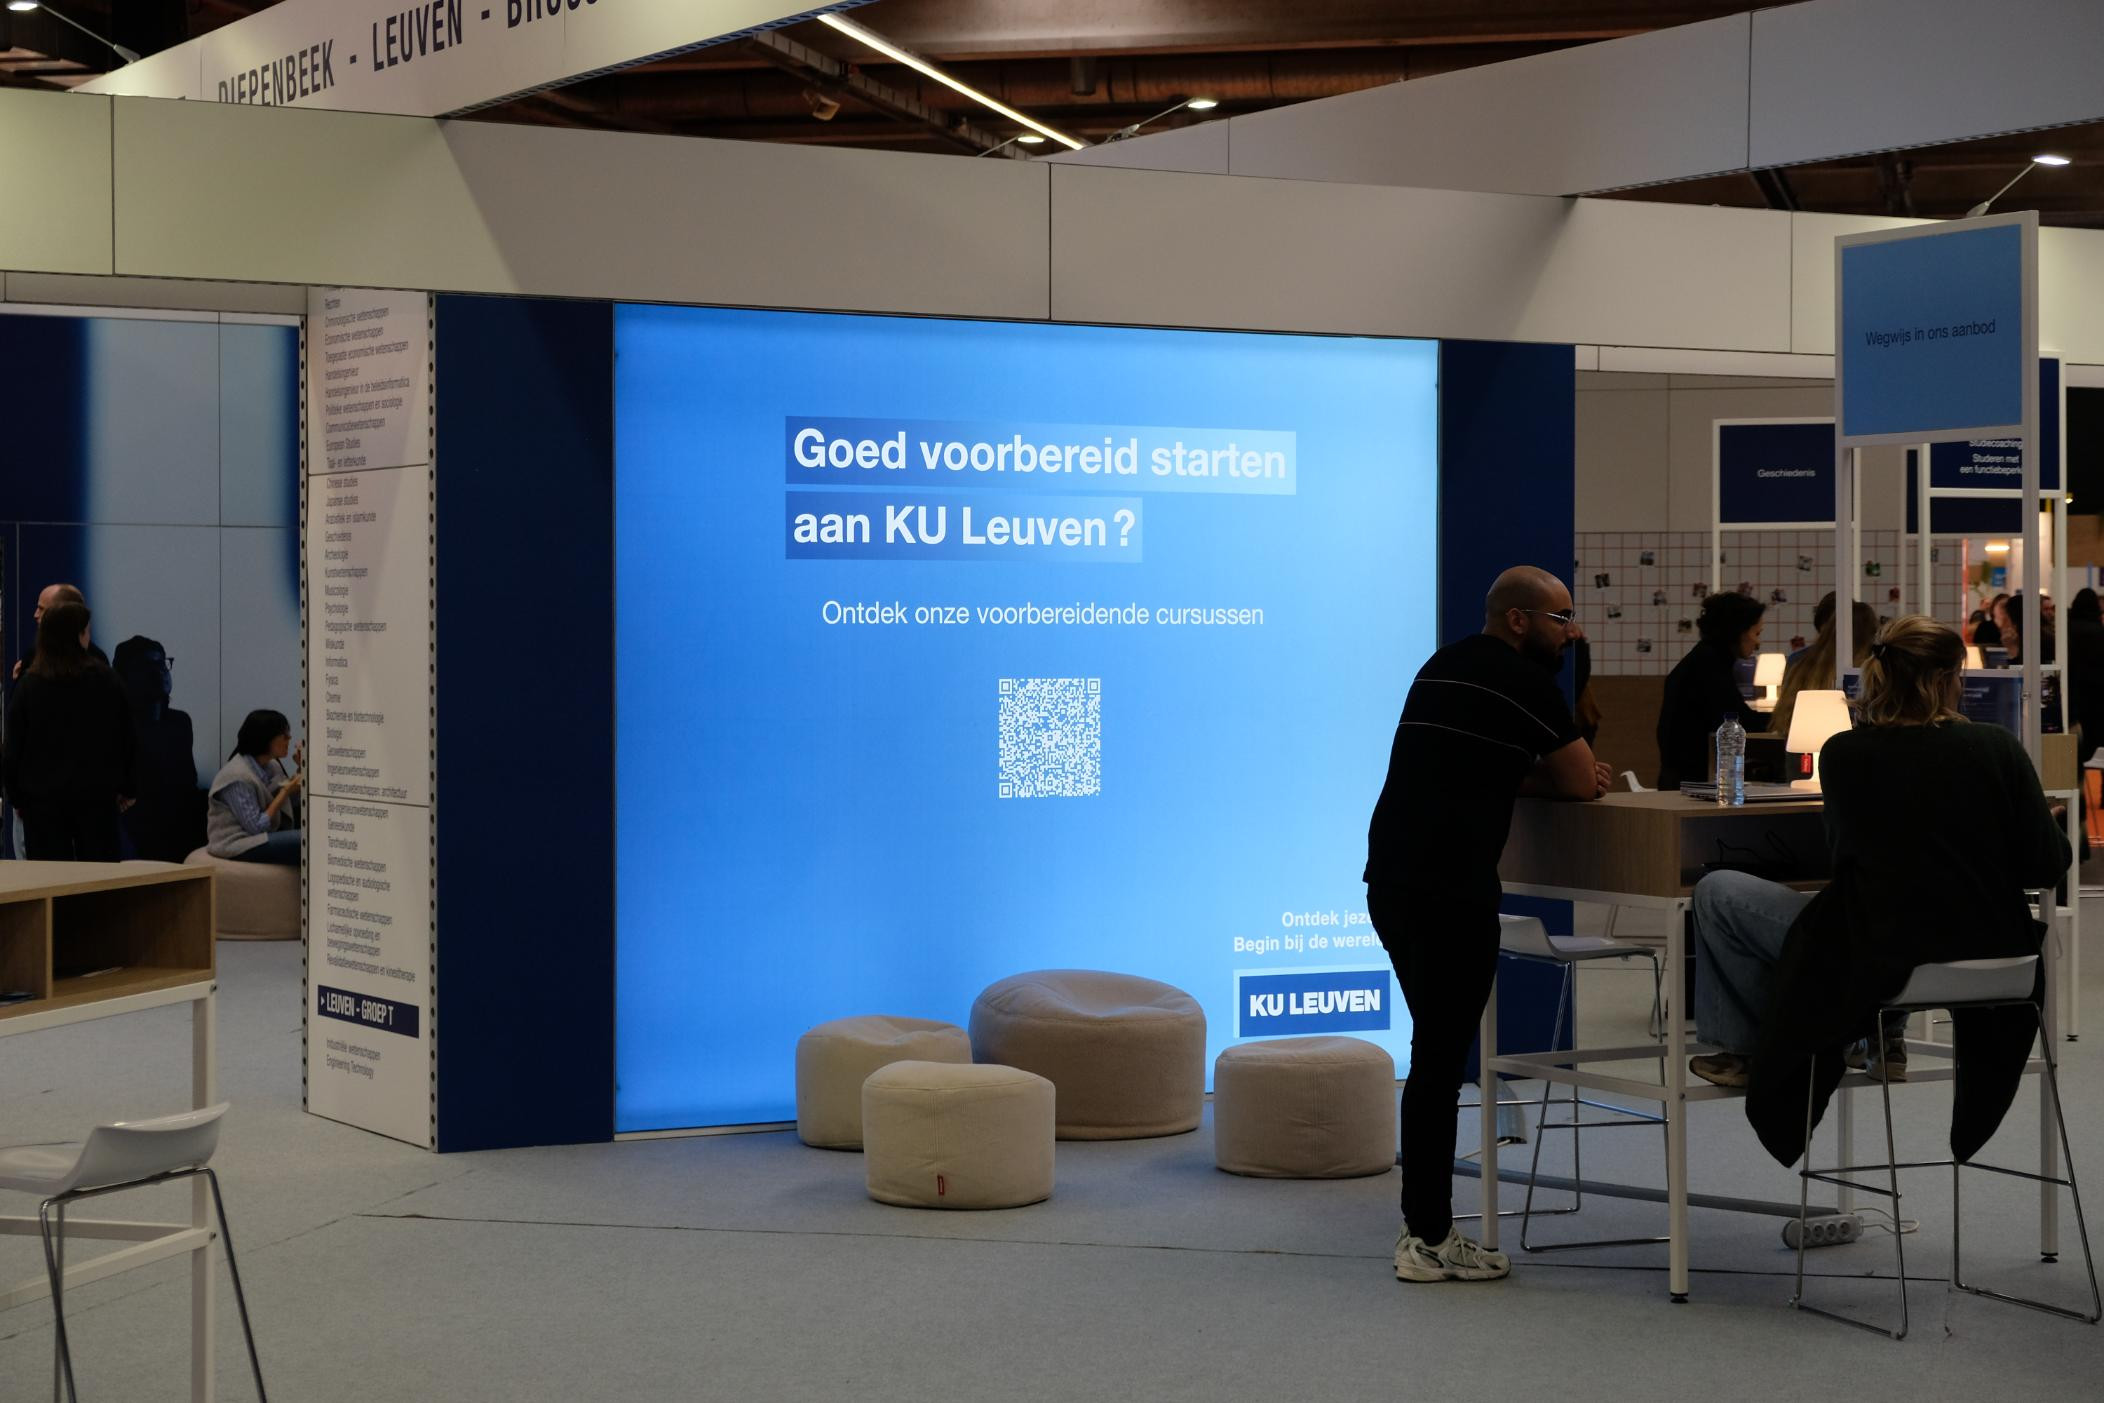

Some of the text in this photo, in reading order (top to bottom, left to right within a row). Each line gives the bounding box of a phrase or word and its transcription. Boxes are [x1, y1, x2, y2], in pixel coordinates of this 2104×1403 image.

[373, 0, 462, 72] LEUVEN
[1866, 318, 1996, 348] Wegwijs in ons aanbod
[793, 427, 1286, 478] Goed voorbereid starten
[794, 511, 870, 544] aan
[886, 505, 947, 545] KU
[822, 600, 1264, 626] Ontdek onze voorbereidende cursussen
[1282, 911, 1339, 928] Ontdek
[1233, 936, 1280, 955] Begin
[1285, 933, 1304, 952] bij
[1309, 933, 1328, 949] de
[327, 992, 355, 1017] LEUVEN
[361, 1000, 387, 1024] GROEP
[388, 1006, 395, 1026] T
[1250, 989, 1381, 1017] KU LEUVEN
